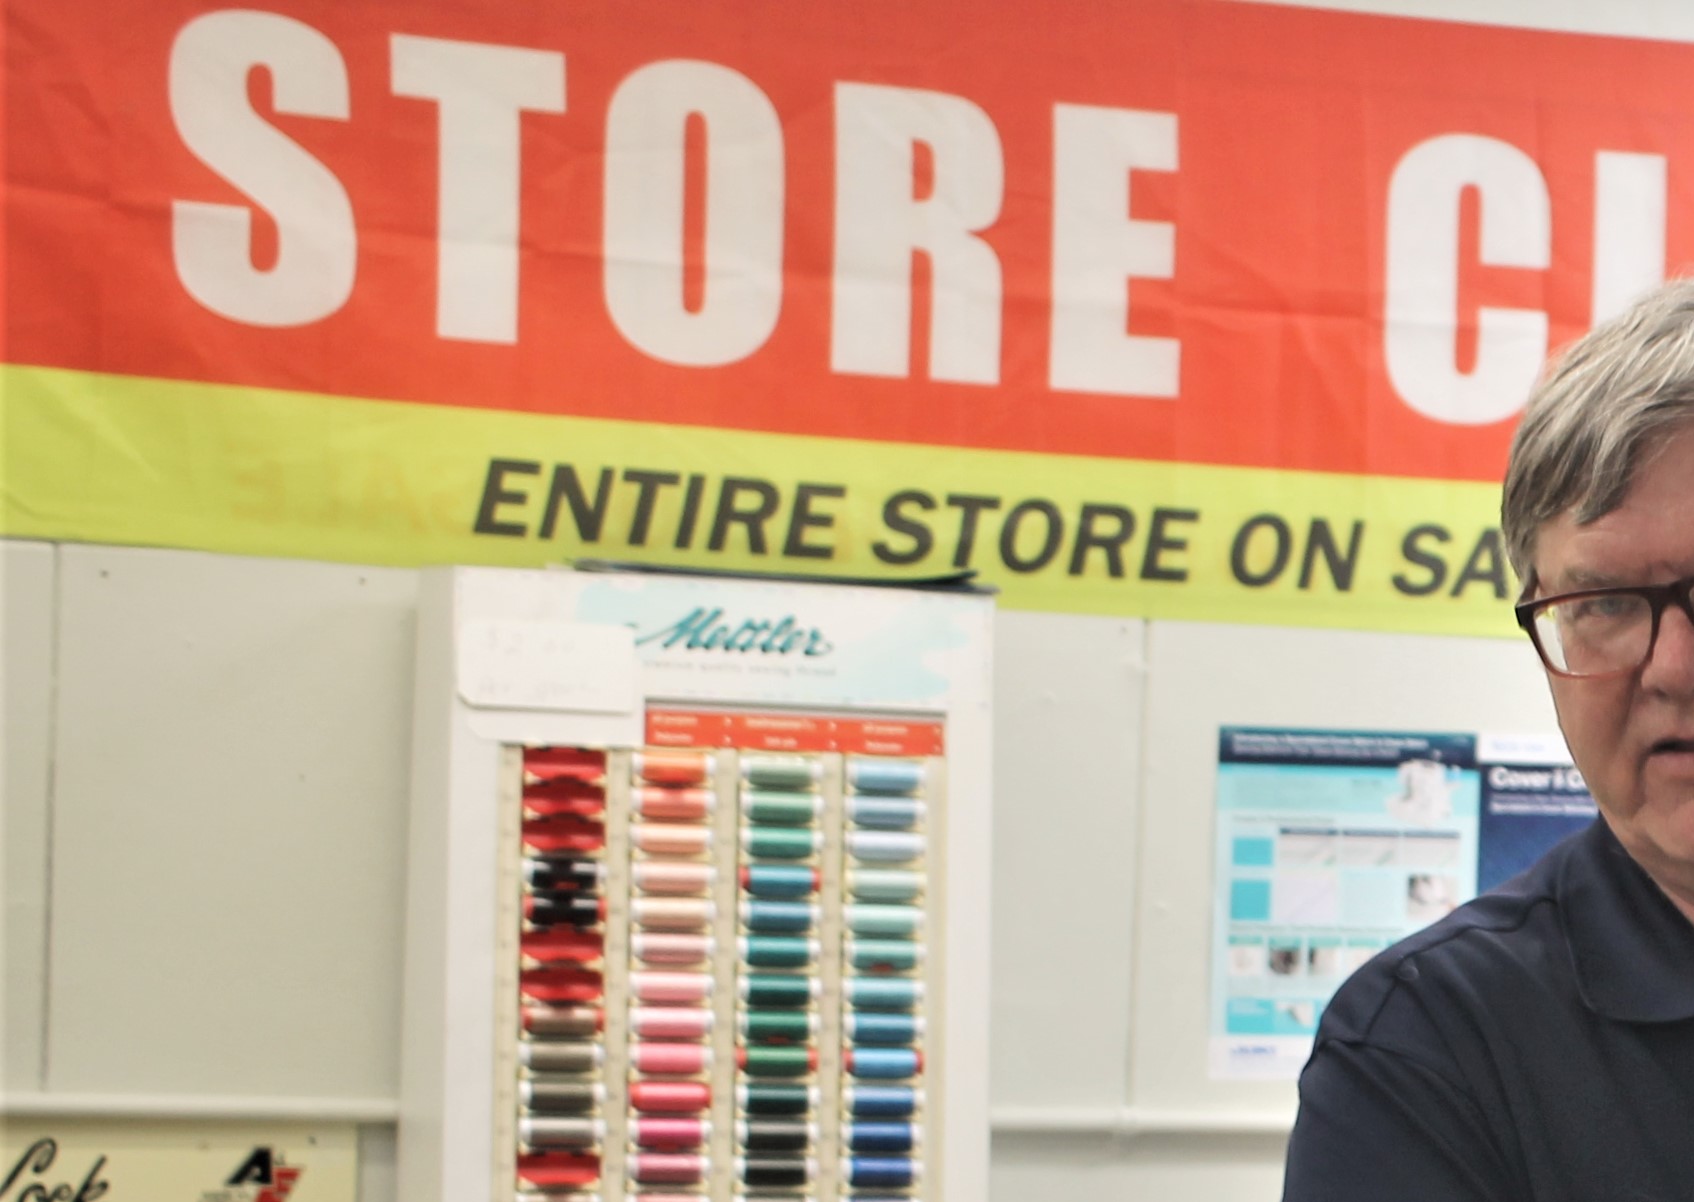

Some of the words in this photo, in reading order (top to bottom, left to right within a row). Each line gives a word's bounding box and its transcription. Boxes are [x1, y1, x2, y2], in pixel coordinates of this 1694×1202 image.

[167, 8, 1181, 398] STORE
[472, 458, 847, 561] ENTIRE
[871, 489, 1199, 584] STORE
[1229, 512, 1366, 592] ON
[1391, 523, 1508, 600] SA
[634, 606, 834, 657] Mettler
